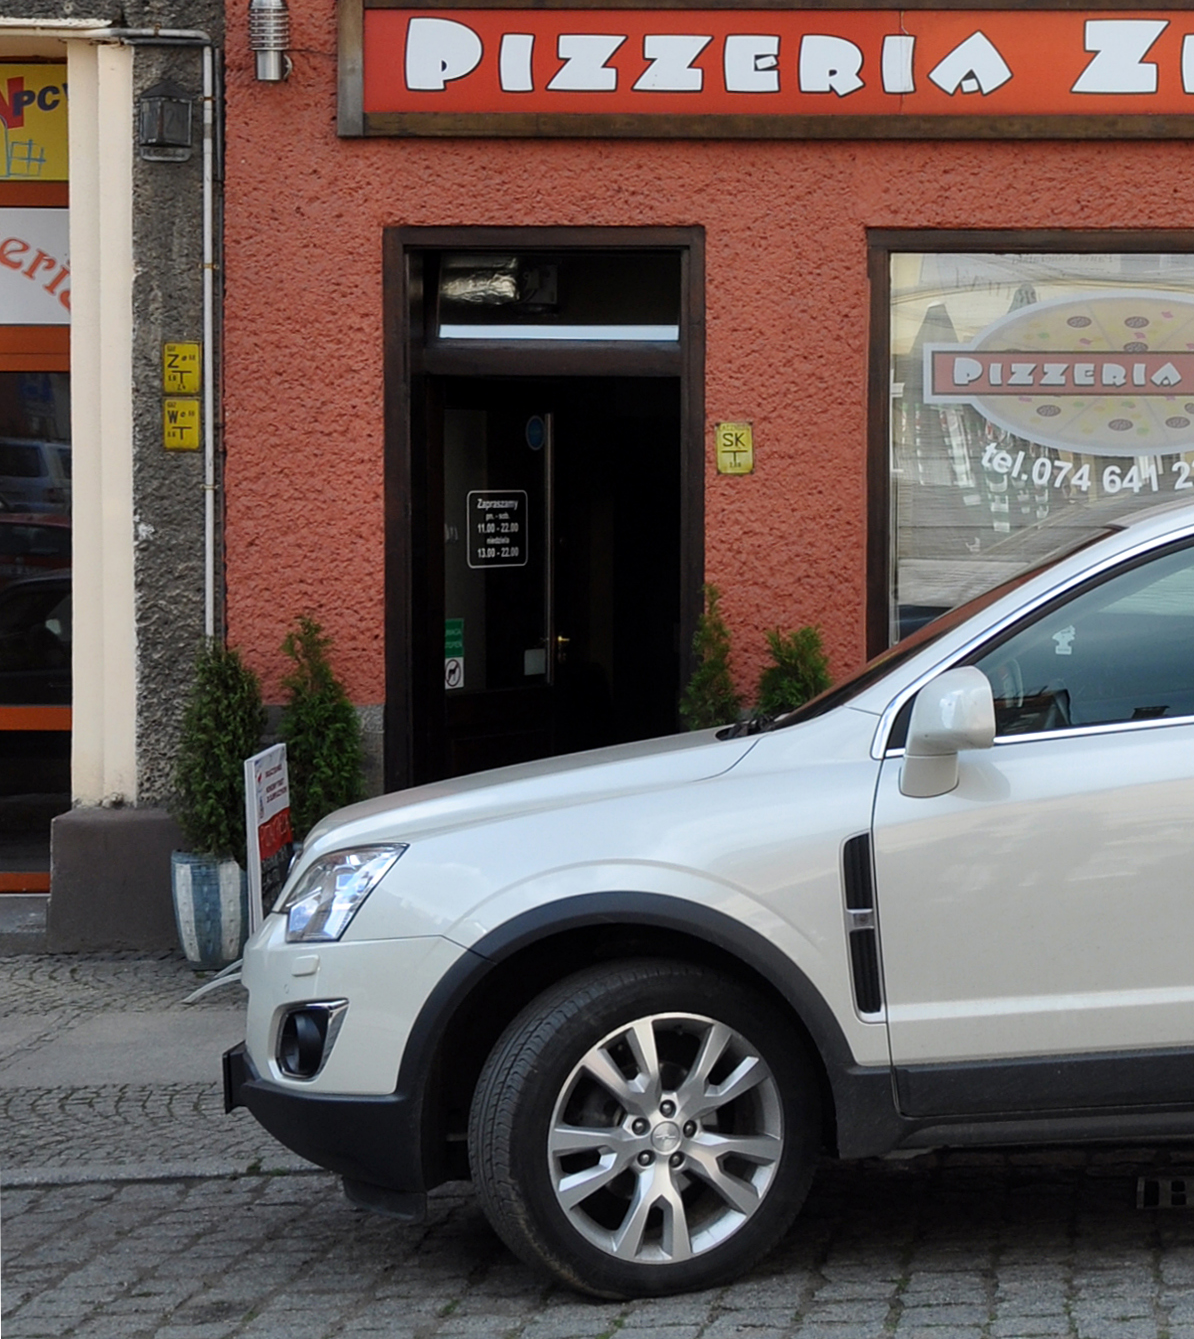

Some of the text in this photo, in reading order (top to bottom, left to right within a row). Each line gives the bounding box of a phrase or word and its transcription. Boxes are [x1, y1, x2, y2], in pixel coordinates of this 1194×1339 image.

[405, 17, 1013, 97] PIZZERIA
[167, 354, 179, 368] Z
[952, 357, 1182, 387] PIZZERIA
[167, 410, 178, 424] W
[722, 432, 745, 447] SK
[1102, 465, 1158, 493] 641
[477, 498, 519, 511] Zapraszamy
[477, 523, 495, 533] 11.00
[501, 522, 519, 533] 22.00
[477, 548, 495, 558] 13.00
[501, 547, 519, 557] 22.00
